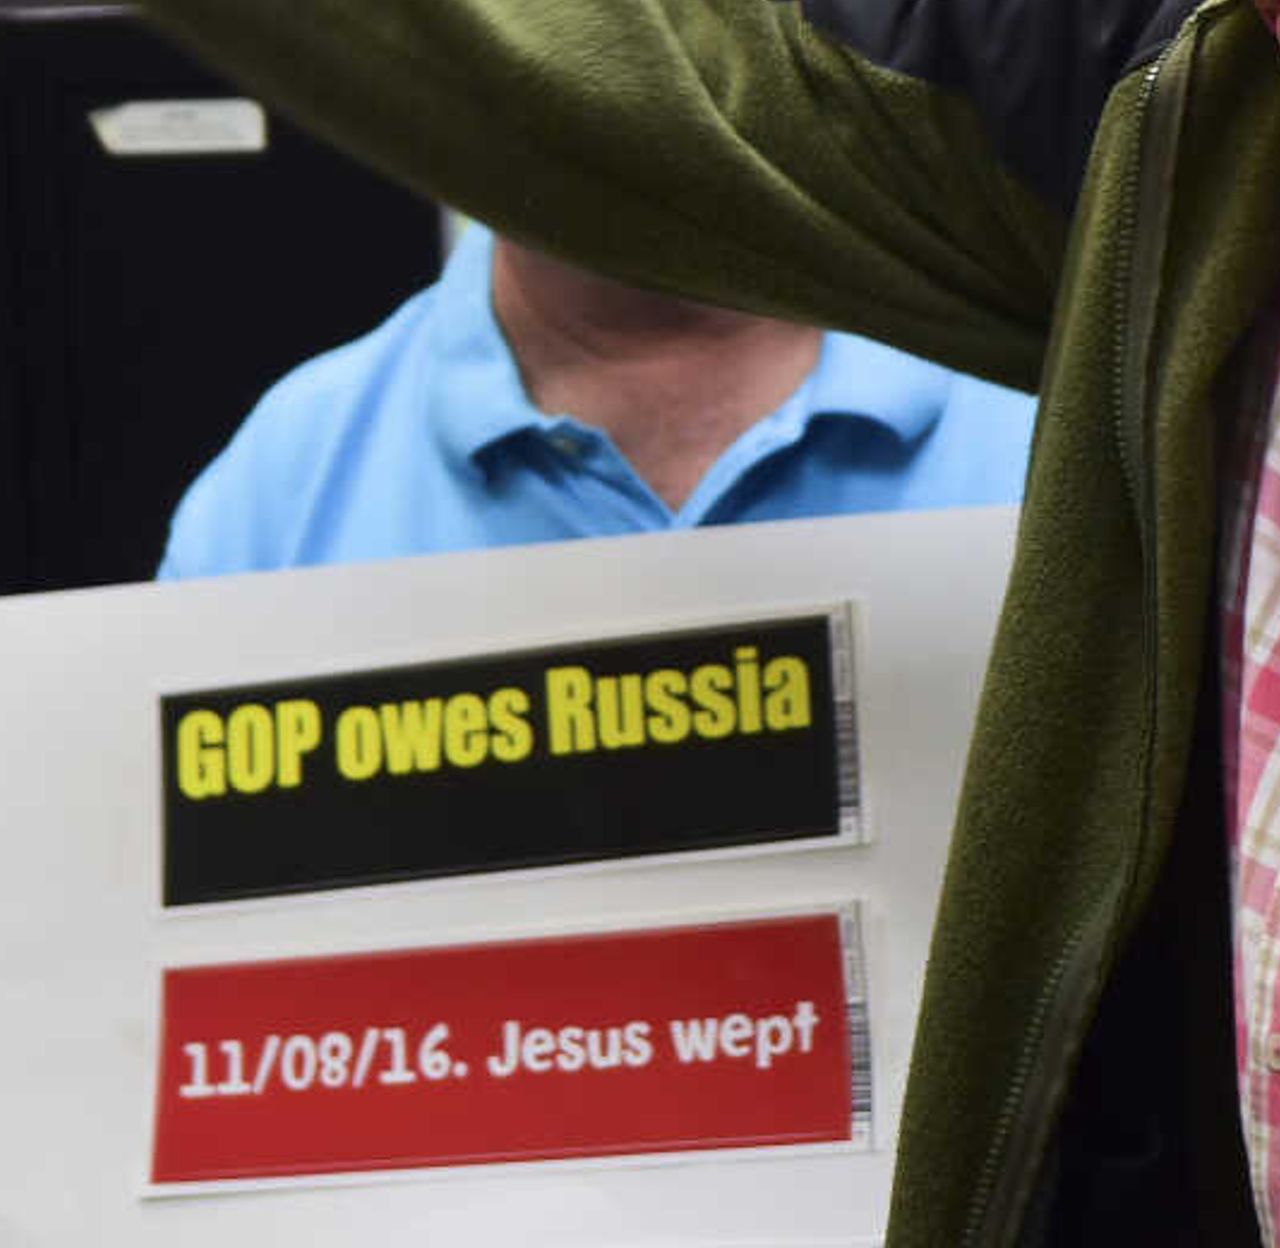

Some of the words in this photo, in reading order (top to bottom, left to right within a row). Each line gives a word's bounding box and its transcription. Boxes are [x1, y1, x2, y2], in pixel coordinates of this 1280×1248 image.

[179, 701, 320, 798] GOP
[338, 689, 532, 779] owes
[548, 648, 809, 753] Russia
[180, 1024, 467, 1098] 11/08/16.
[488, 1021, 652, 1076] Jesus
[671, 1002, 818, 1068] wept
